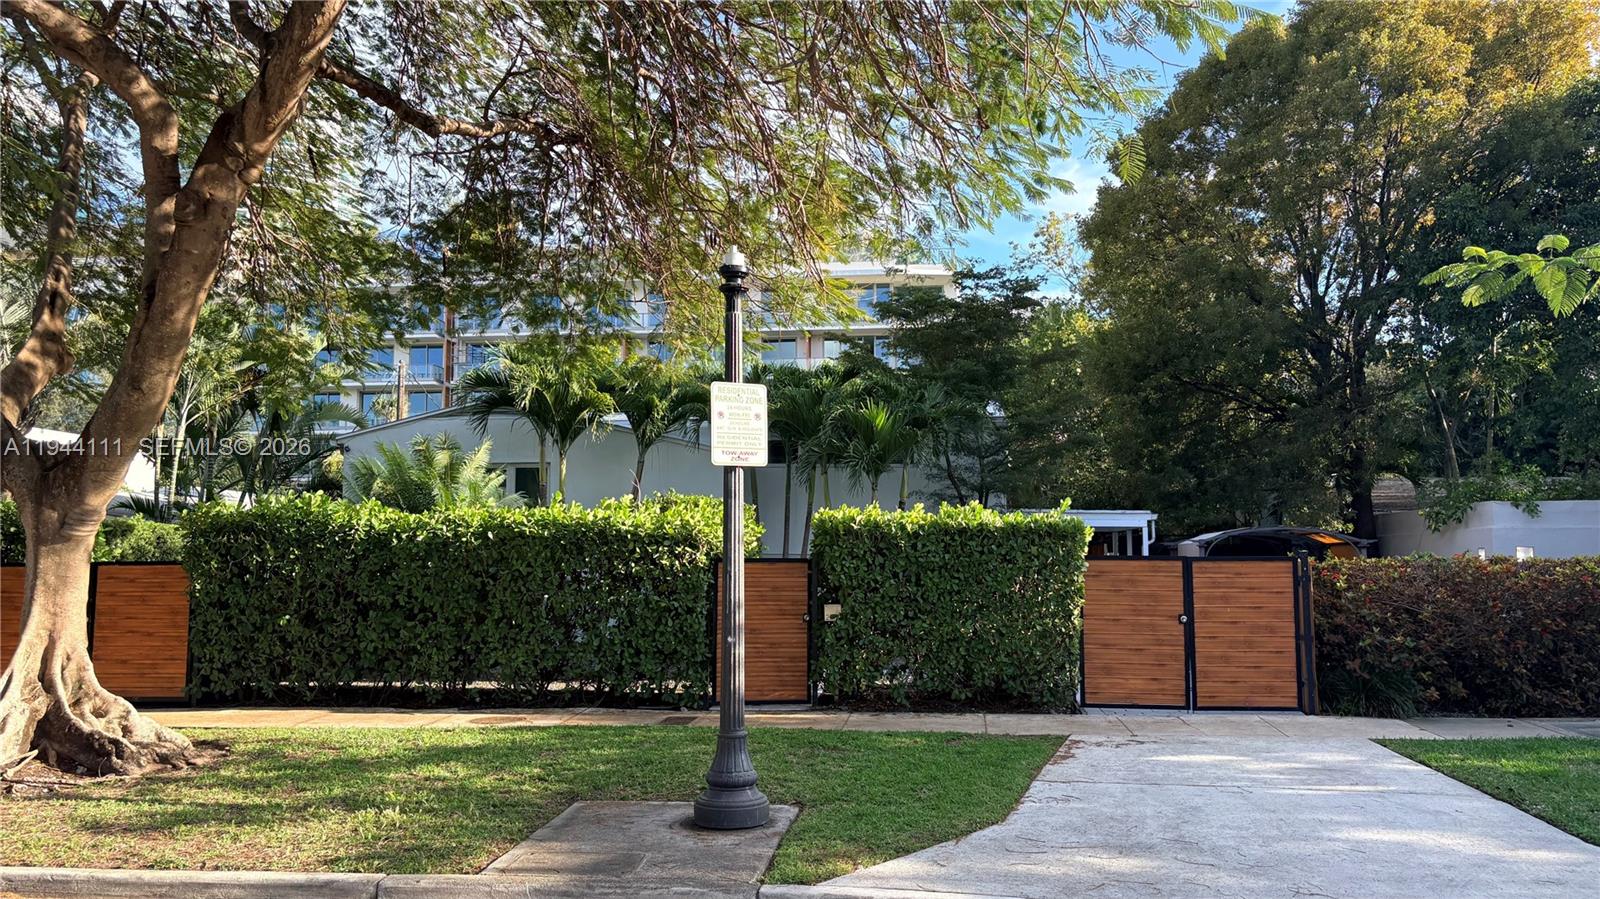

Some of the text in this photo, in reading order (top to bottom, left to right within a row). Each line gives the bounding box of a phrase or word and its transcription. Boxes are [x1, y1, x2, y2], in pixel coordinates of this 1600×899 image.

[717, 386, 760, 396] RESIDENTIAL
[715, 394, 764, 405] PARKING ZONE
